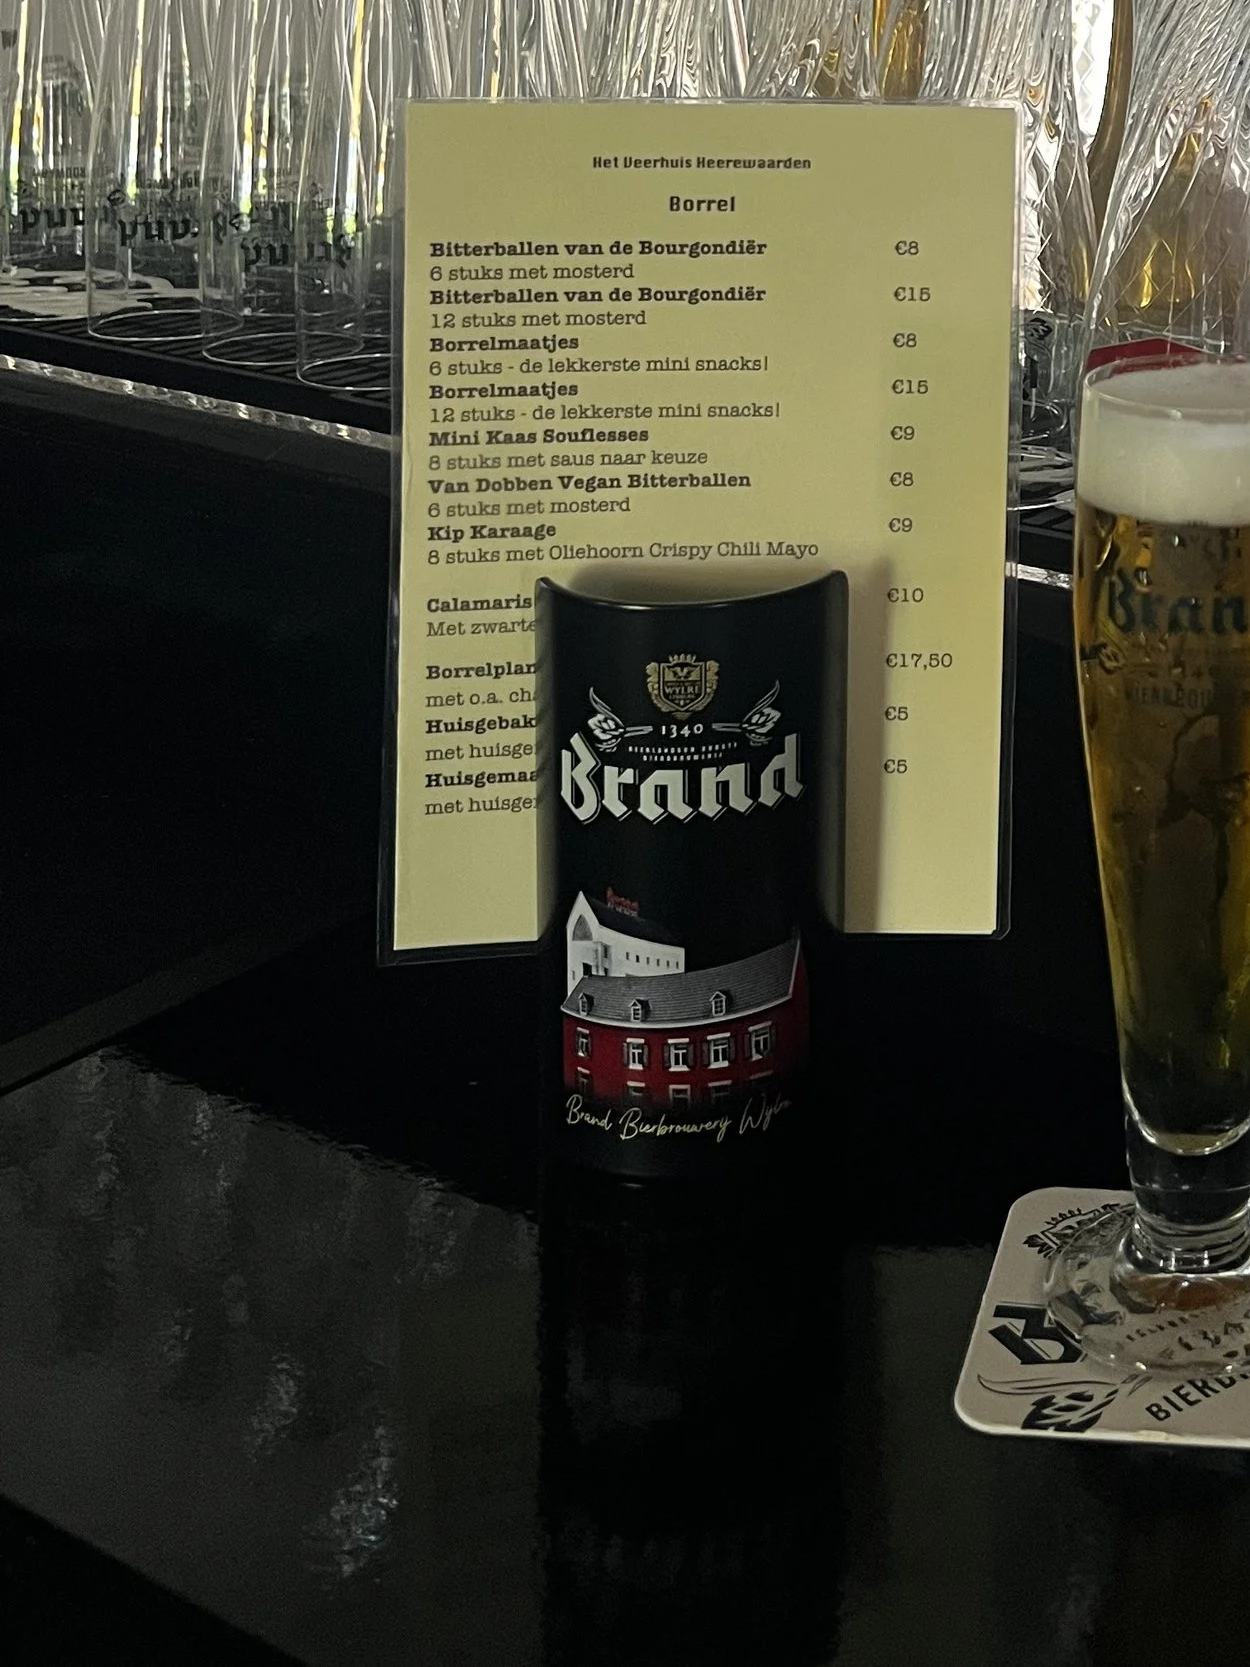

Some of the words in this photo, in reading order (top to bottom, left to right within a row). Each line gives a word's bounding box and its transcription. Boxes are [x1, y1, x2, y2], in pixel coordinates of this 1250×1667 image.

[593, 157, 618, 168] Het
[697, 157, 811, 169] Heerewaarden
[670, 196, 735, 212] Borrel
[430, 241, 559, 257] Bitterballen
[564, 244, 604, 255] van
[609, 241, 633, 255] de
[638, 240, 767, 258] Bourgondiër
[895, 241, 919, 255] €8
[430, 266, 442, 281] 6
[449, 265, 503, 281] stuks
[508, 265, 548, 280] met
[553, 263, 635, 279] mosterd
[430, 289, 559, 305] Bitterballen
[563, 291, 603, 302] van
[609, 287, 632, 302] de
[638, 286, 766, 305] Bourgondiër
[894, 287, 930, 302] €15
[432, 313, 455, 329] 12
[462, 312, 516, 328] stuks
[521, 312, 561, 326] met
[565, 310, 647, 326] mosterd
[430, 334, 579, 353] Borrelmaatjes
[893, 333, 917, 348] €8
[429, 361, 442, 376] 6
[448, 359, 502, 375] stuks
[520, 359, 543, 373] de
[548, 358, 640, 373] lekkerste
[646, 357, 690, 371] mini
[429, 381, 578, 400] Borrelmaatjes
[892, 379, 928, 394] €15
[431, 407, 455, 423] 12
[460, 406, 515, 422] stuks
[532, 405, 555, 420] de
[560, 404, 652, 420] lekkerste
[658, 403, 702, 418] mini
[429, 430, 480, 446] Mini
[485, 430, 537, 445] Kaas
[890, 426, 915, 440] €9
[428, 455, 441, 471] 8
[447, 454, 502, 470] stuks
[506, 453, 546, 468] met
[550, 454, 594, 467] saus
[600, 453, 646, 465] naar
[651, 450, 708, 465] keuze
[427, 480, 470, 494] Van
[475, 477, 553, 492] Dobben
[557, 475, 622, 493] Vegan
[627, 473, 751, 488] Bitterballen
[890, 472, 913, 486] €8
[428, 503, 440, 518] 6
[446, 501, 500, 517] stuks
[506, 500, 545, 515] met
[549, 497, 631, 514] mosterd
[428, 525, 464, 543] Kip
[470, 524, 556, 541] Karaage
[889, 518, 912, 533] €9
[428, 550, 440, 565] 8
[445, 548, 500, 564] stuks
[506, 547, 544, 561] met
[549, 544, 644, 560] Oliehoorn
[649, 543, 713, 560] Crispy
[717, 542, 761, 557] Chili
[766, 542, 818, 559] Mayo
[427, 594, 532, 613] Calamaris
[887, 588, 923, 603] €10
[426, 621, 466, 637] Met
[886, 653, 952, 670] €17,50
[425, 692, 465, 707] met
[469, 693, 503, 705] o.a.
[885, 706, 908, 721] €5
[661, 723, 704, 739] 1340
[425, 745, 464, 761] met
[469, 743, 533, 759] huisge
[884, 759, 907, 773] €5
[560, 732, 804, 825] Brand
[425, 799, 463, 815] met
[468, 796, 537, 812] huisge
[566, 1094, 613, 1131] Brand
